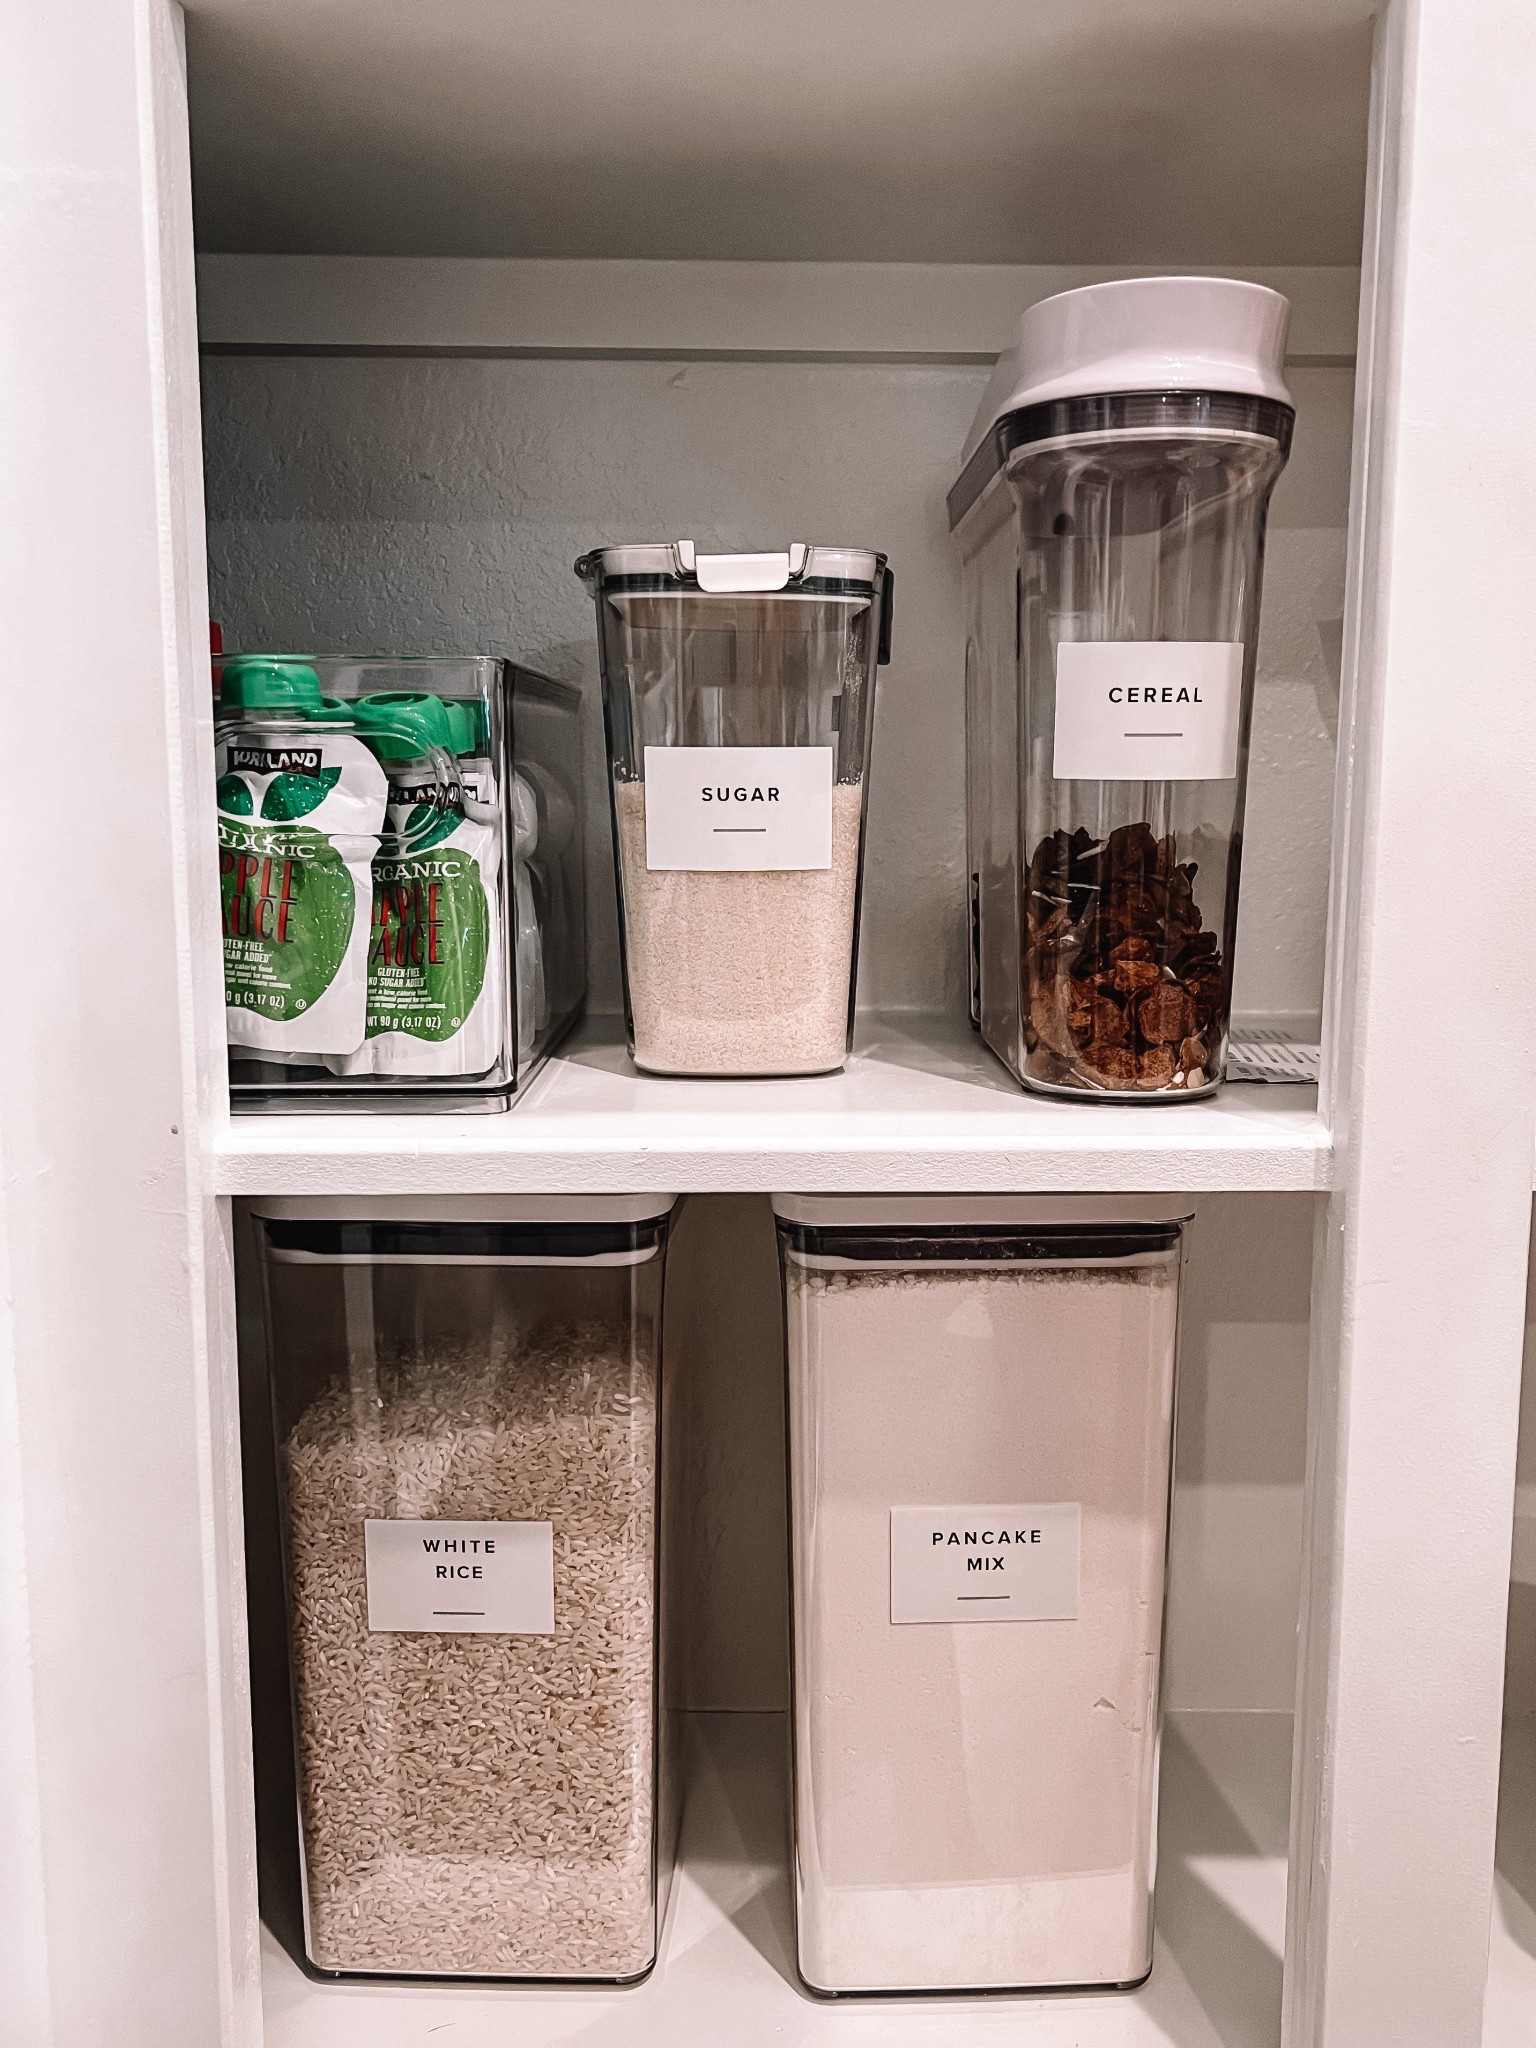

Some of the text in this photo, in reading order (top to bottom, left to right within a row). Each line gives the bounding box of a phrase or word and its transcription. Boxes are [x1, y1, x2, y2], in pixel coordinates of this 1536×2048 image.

[1108, 687, 1203, 703] CEREAL
[701, 787, 780, 802] SUGAR
[220, 852, 298, 901] PPLE
[371, 861, 461, 882] RGANIC
[380, 977, 404, 988] SUGAR
[380, 1015, 391, 1027] 90
[392, 1018, 400, 1030] g
[401, 1015, 423, 1029] (3.17
[932, 1530, 1041, 1546] PANCAKE
[422, 1539, 496, 1554] WHITE
[967, 1557, 1005, 1571] MIX
[435, 1565, 483, 1579] RICE
